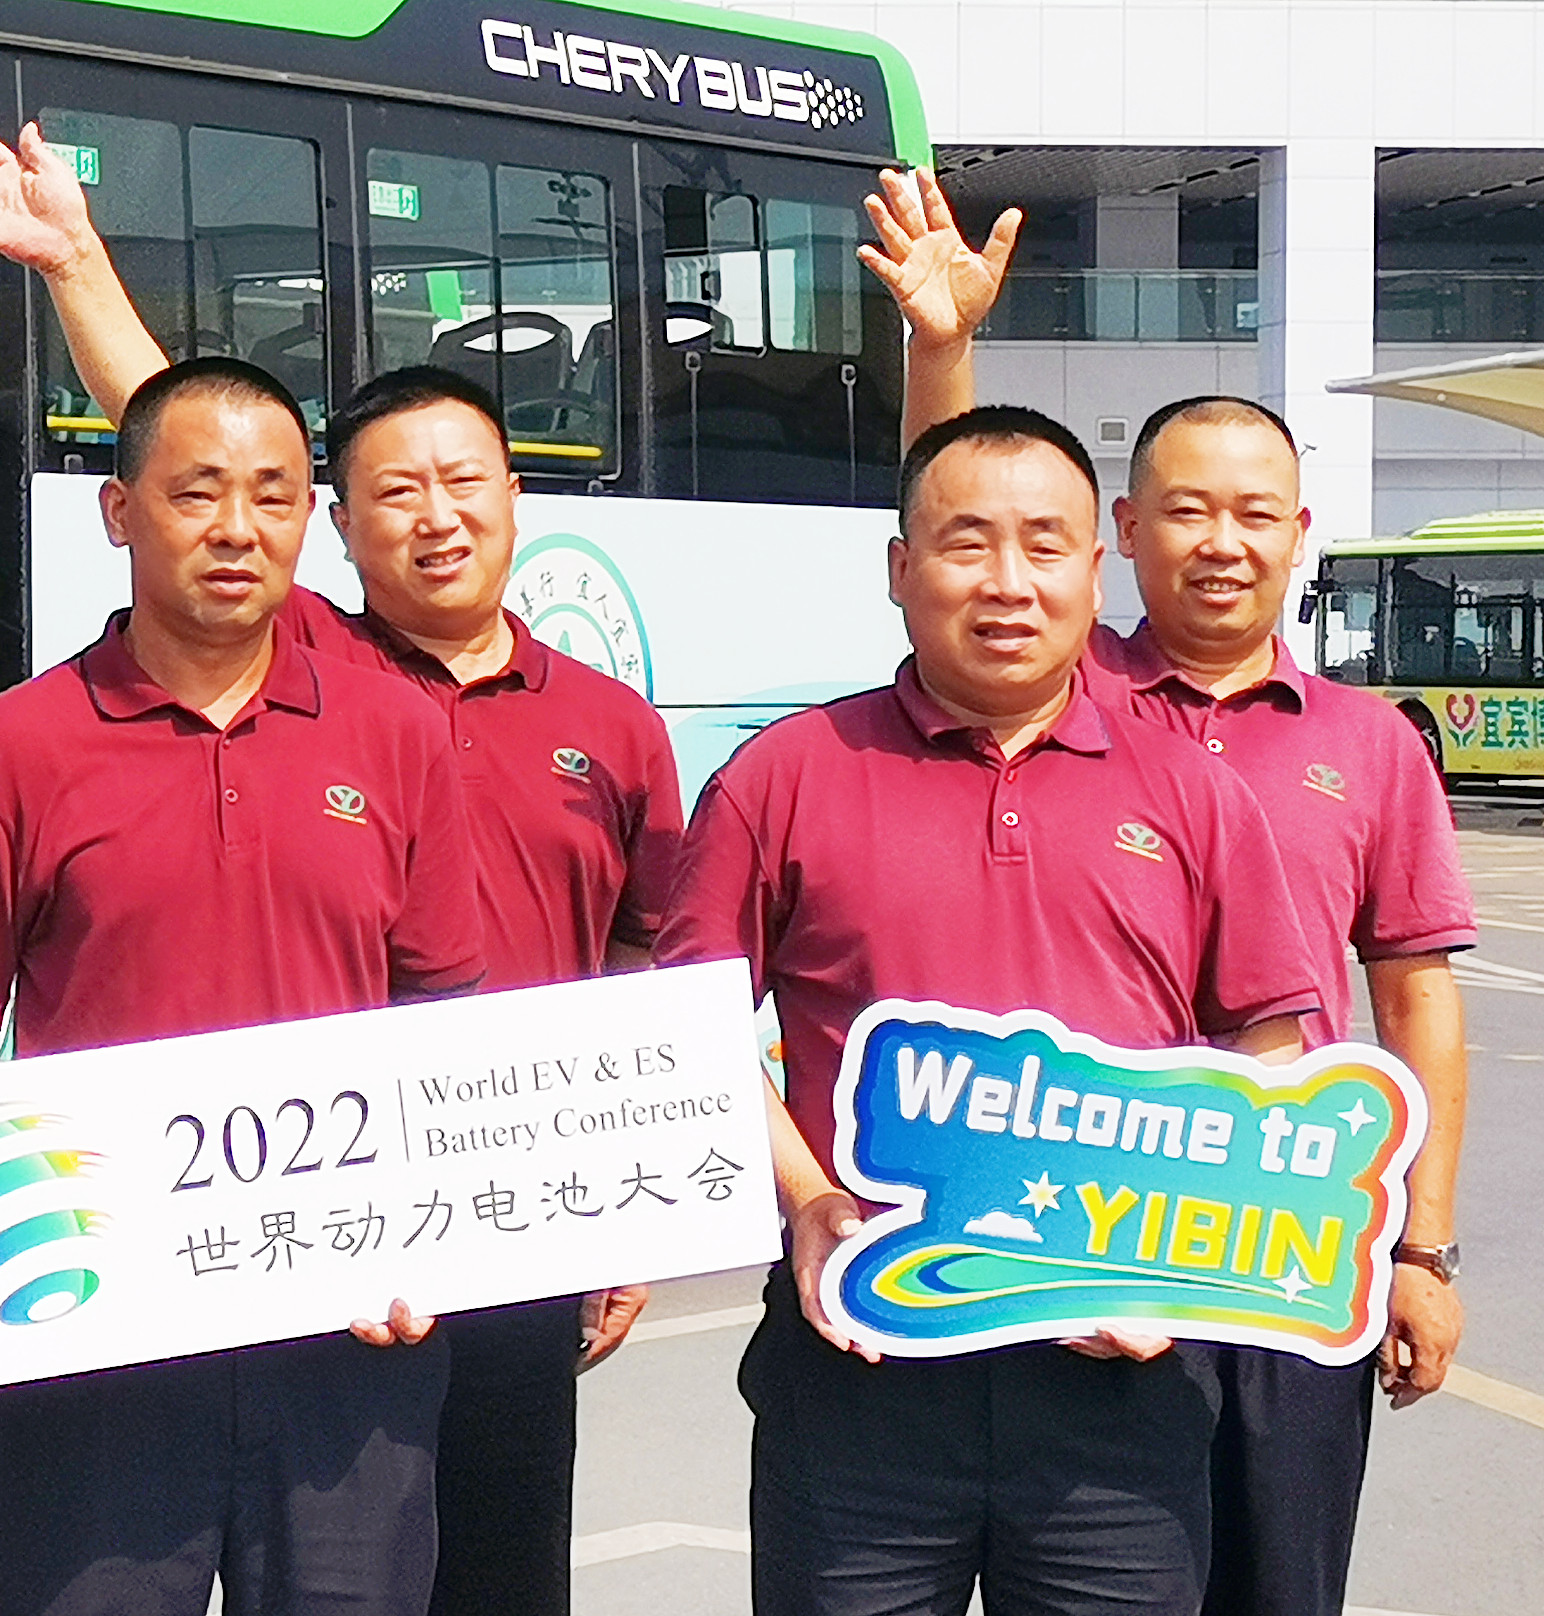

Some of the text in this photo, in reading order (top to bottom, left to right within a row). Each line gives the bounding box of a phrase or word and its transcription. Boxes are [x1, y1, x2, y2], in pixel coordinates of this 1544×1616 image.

[418, 1043, 677, 1106] World EV & ES
[425, 1089, 733, 1158] Battery Conference
[896, 1046, 1338, 1178] Welcome to
[165, 1090, 379, 1194] 2022
[175, 1146, 746, 1278] 世界动力电池大会
[1075, 1180, 1343, 1287] YIBIN
